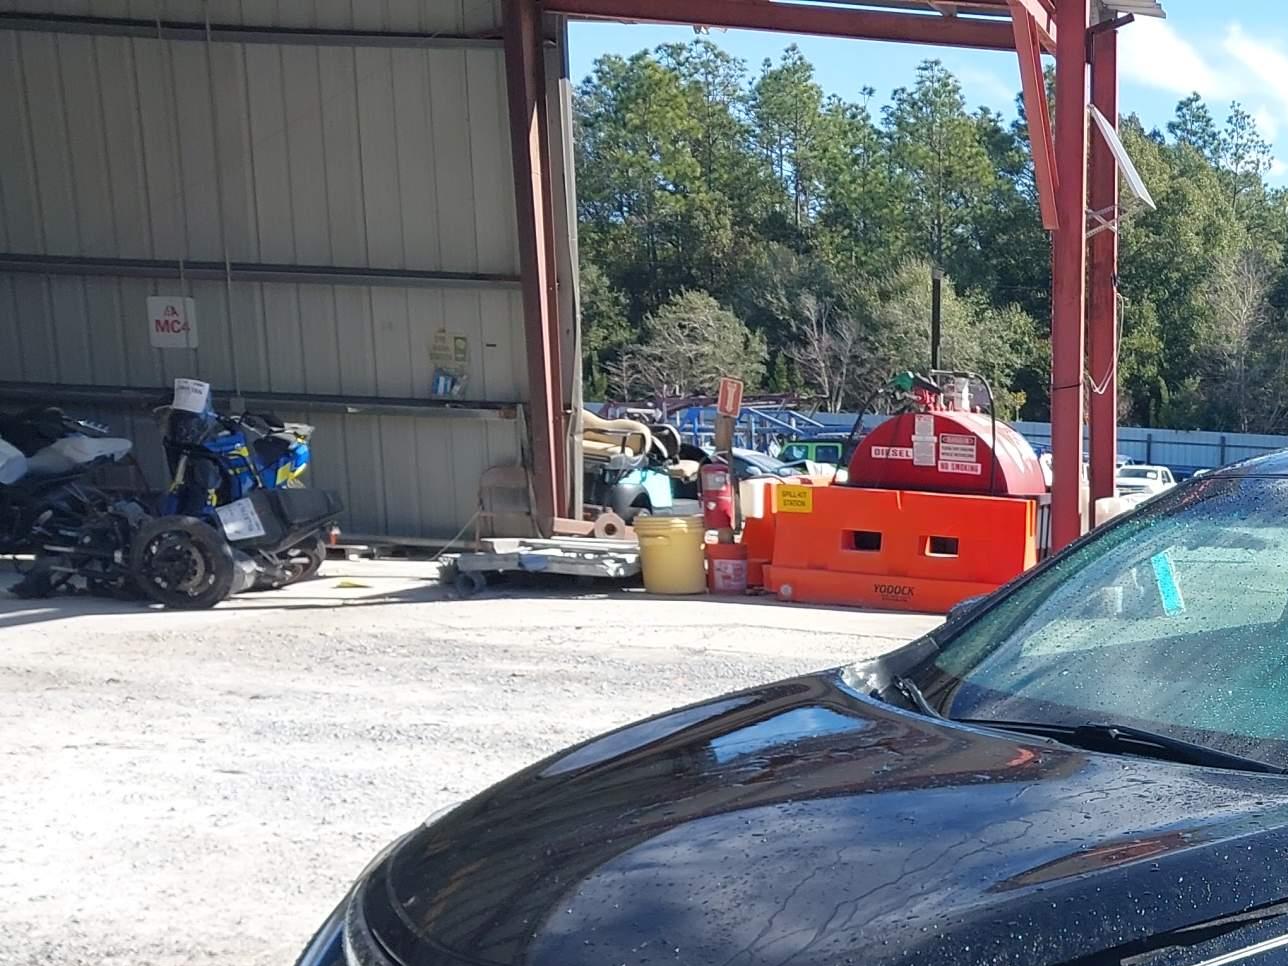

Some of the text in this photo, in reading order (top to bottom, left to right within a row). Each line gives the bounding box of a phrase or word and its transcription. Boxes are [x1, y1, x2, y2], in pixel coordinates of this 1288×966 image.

[874, 448, 912, 457] DIESEL
[940, 462, 979, 473] NO SMOKING
[872, 584, 915, 596] YODOCK
